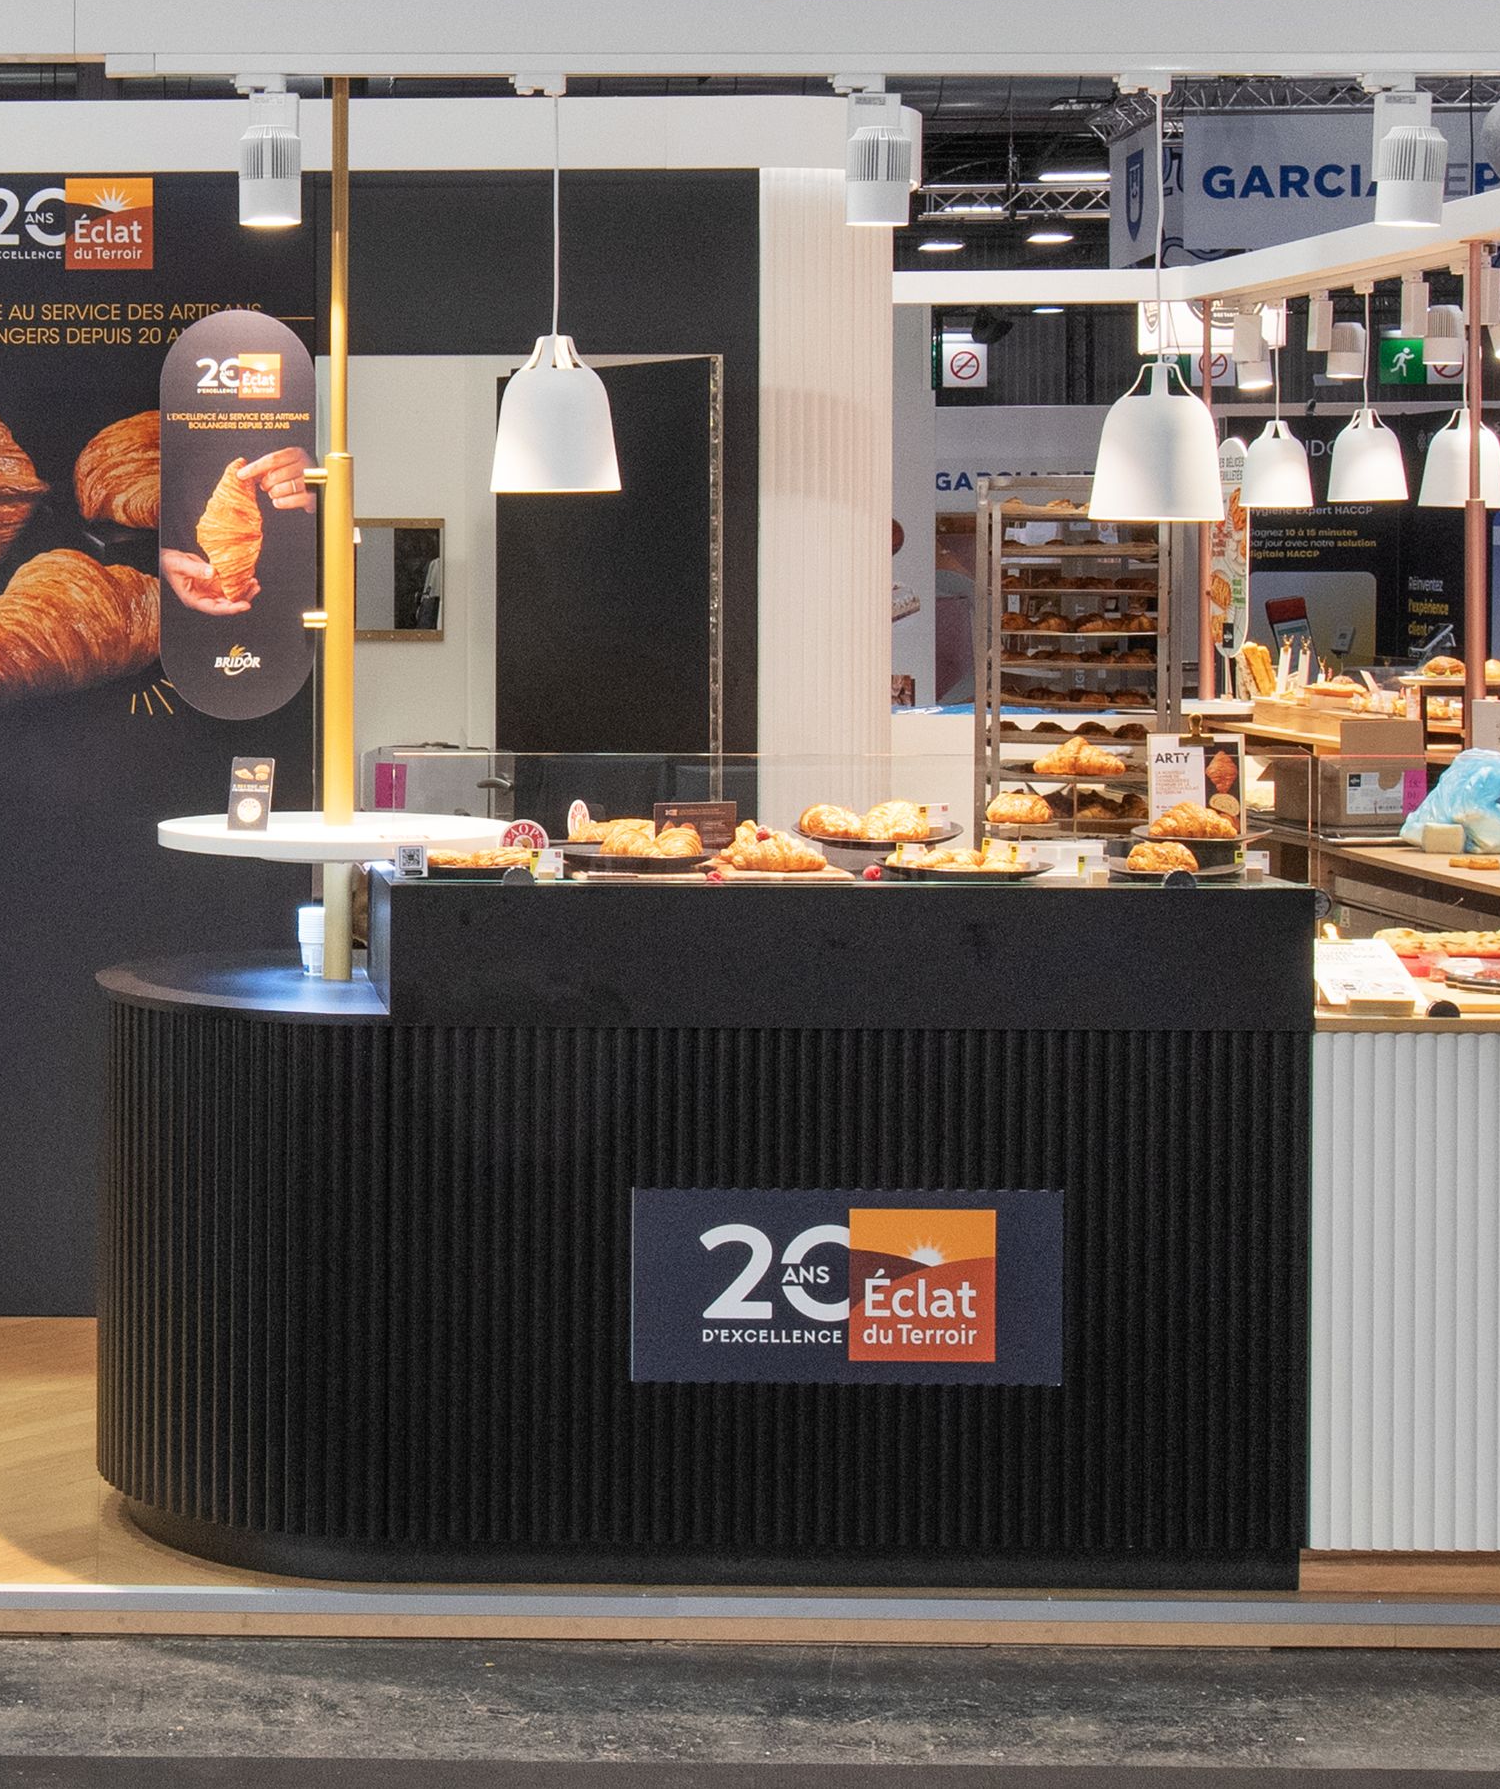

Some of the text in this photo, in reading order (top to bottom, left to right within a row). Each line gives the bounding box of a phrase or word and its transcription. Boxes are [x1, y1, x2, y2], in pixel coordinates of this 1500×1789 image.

[25, 212, 55, 225] ANS
[74, 214, 143, 245] Éclat
[73, 246, 143, 260] du Terroir
[8, 303, 35, 321] AU
[41, 301, 120, 321] SERVICE
[127, 301, 164, 320] DES
[66, 327, 132, 345] DEPUIS
[137, 326, 163, 344] 20
[242, 370, 276, 386] Éclat
[217, 412, 228, 422] AU
[229, 412, 258, 422] SERVICE
[259, 412, 275, 422] DES
[275, 412, 310, 422] ARTISANS
[188, 421, 290, 430] BOULANGERS DEPUIS 20 ANS
[1334, 505, 1373, 516] HACCP
[1285, 528, 1358, 537] 10 minutes
[1285, 540, 1308, 548] avec
[1310, 539, 1335, 548] notre
[1336, 539, 1377, 548] solution
[1286, 550, 1320, 559] HACCP
[214, 655, 261, 669] BRIDOR
[1155, 752, 1191, 764] ARTY
[508, 824, 540, 840] AOP
[781, 1265, 831, 1285] ANS
[864, 1268, 977, 1319] Éclat
[702, 1328, 843, 1345] D'EXCELLENCE
[862, 1323, 978, 1345] du Terroir
